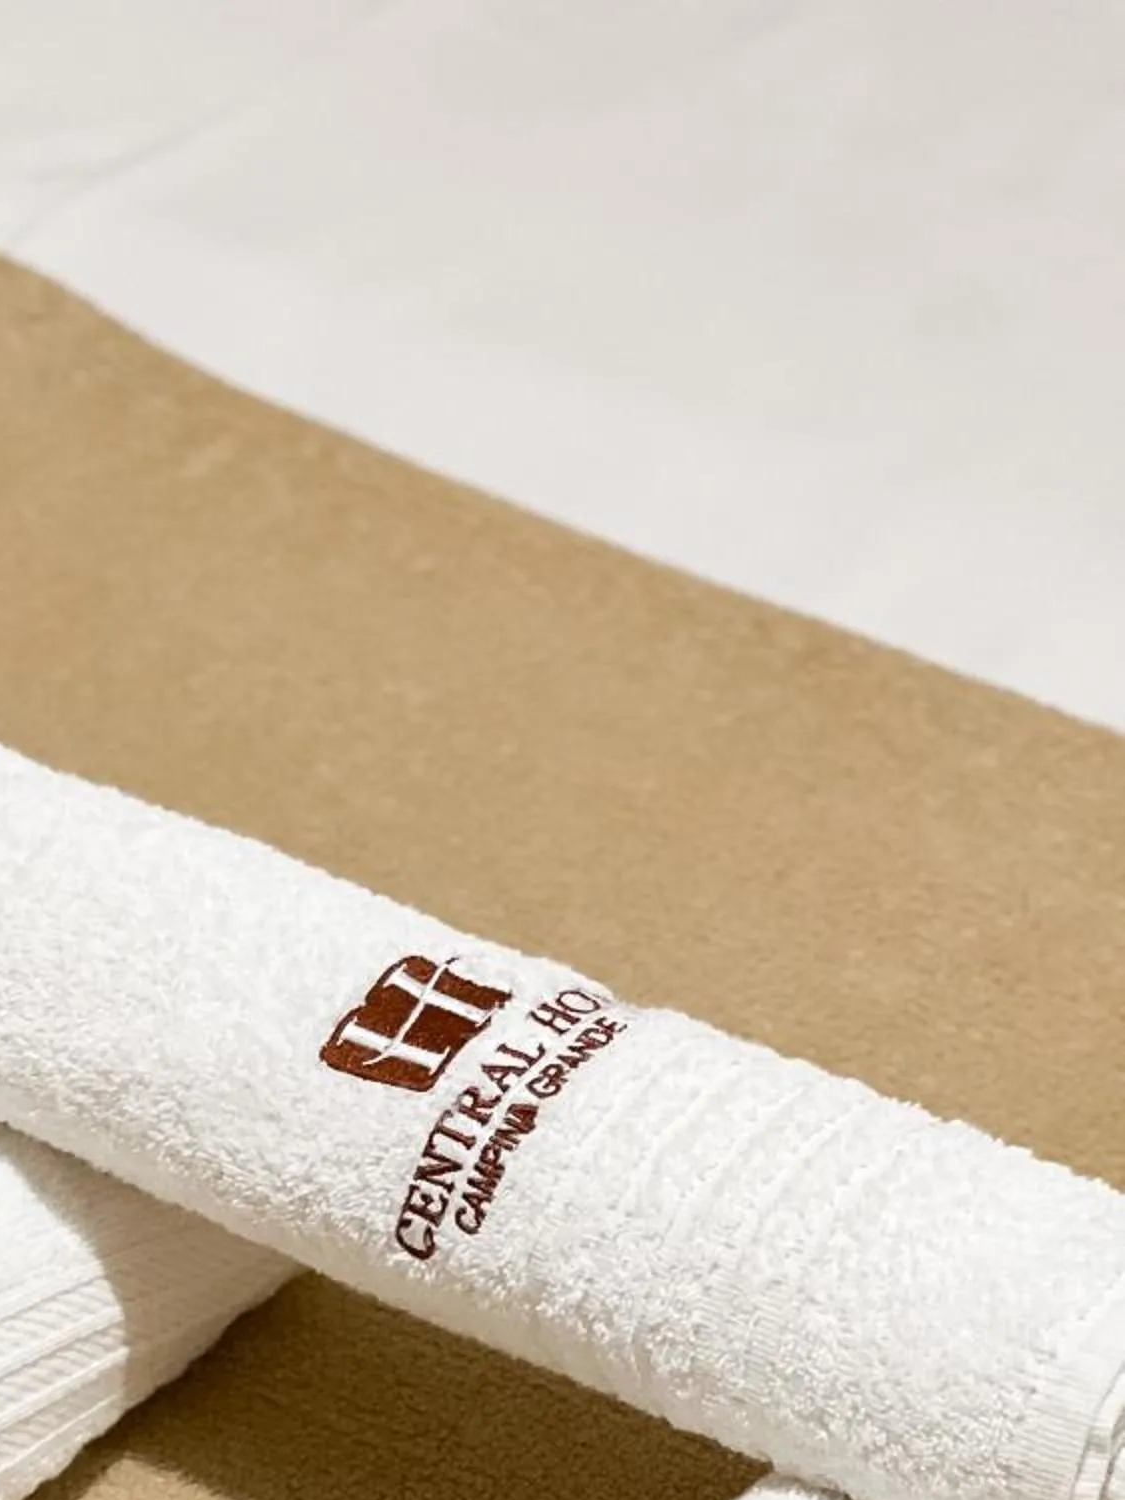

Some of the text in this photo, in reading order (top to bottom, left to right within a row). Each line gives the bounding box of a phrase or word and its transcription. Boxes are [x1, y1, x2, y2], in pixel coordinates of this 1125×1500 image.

[395, 989, 605, 1260] CENTRAL HO
[454, 1016, 628, 1235] CAMPINA GRANDE
